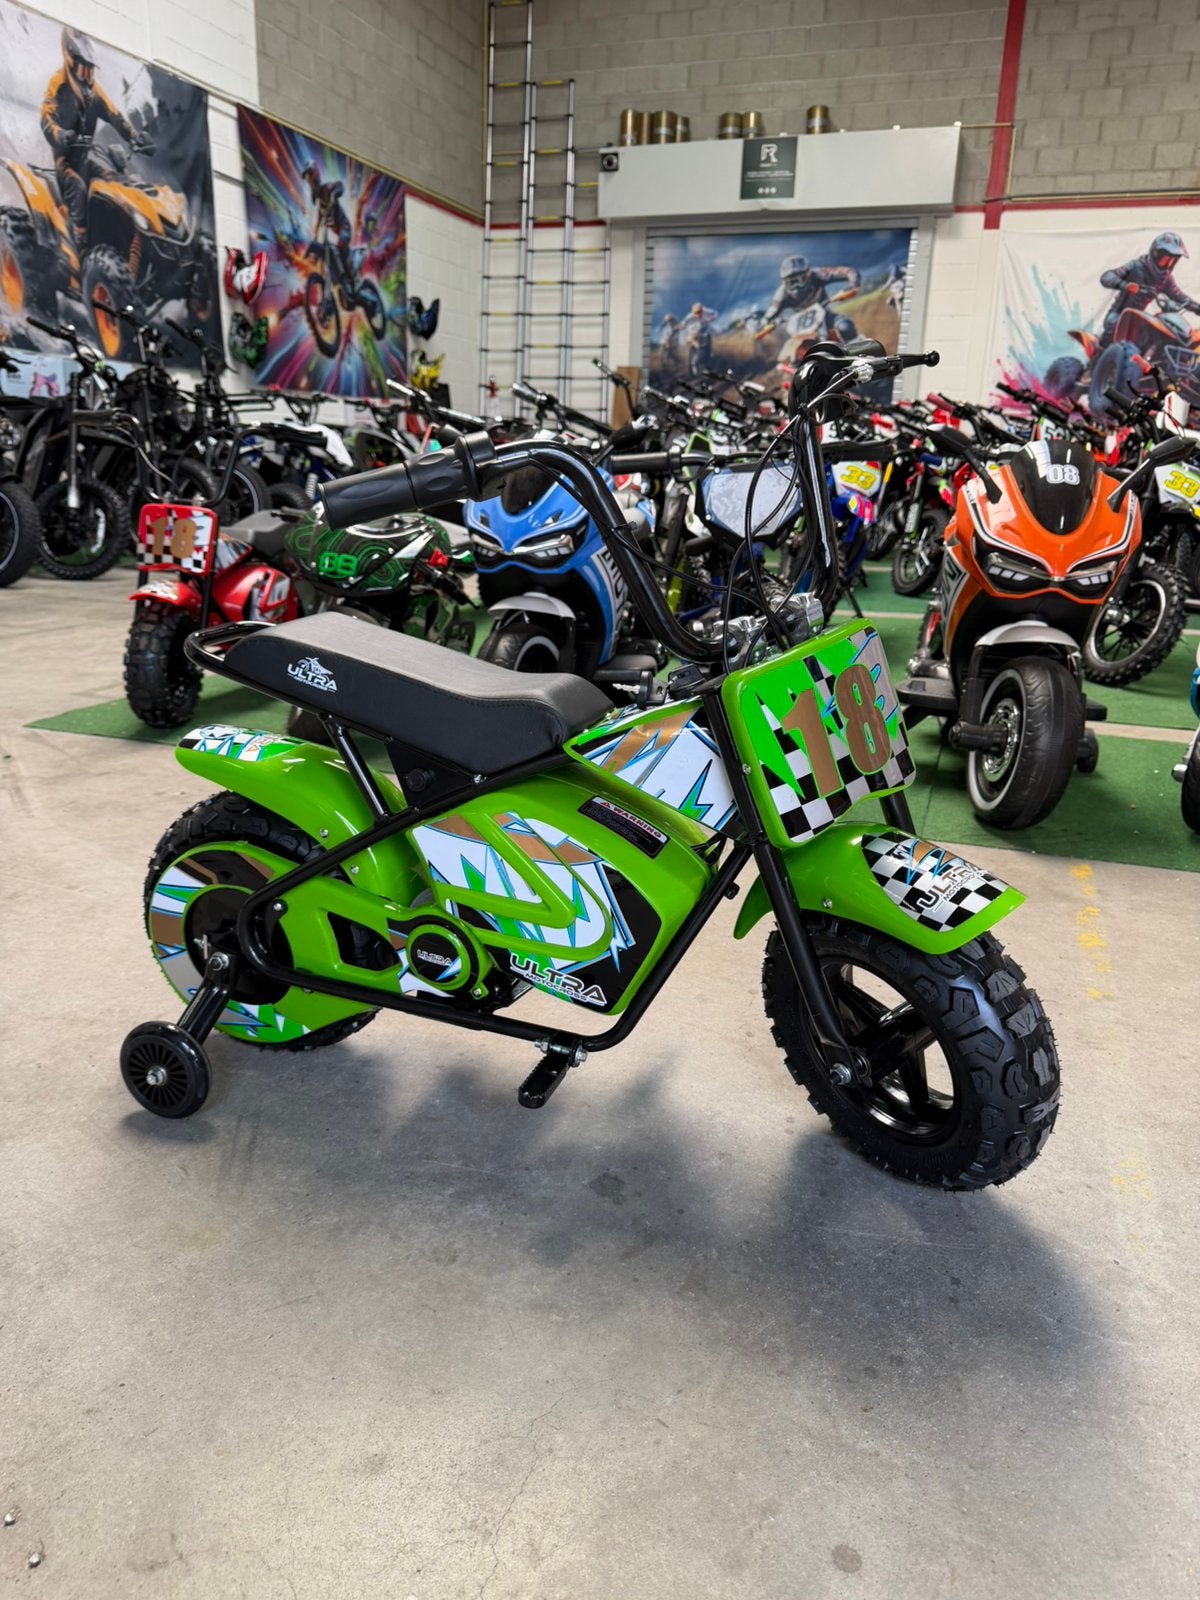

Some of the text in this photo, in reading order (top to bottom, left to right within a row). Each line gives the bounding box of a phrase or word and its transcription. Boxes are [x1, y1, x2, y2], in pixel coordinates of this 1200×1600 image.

[1046, 463, 1081, 486] 08
[150, 517, 197, 559] 18
[287, 663, 338, 691] ULTRA
[781, 664, 891, 799] 18
[613, 806, 661, 839] WARNING
[510, 953, 607, 1004] ULTRA
[525, 973, 588, 1002] MOTOCROSS
